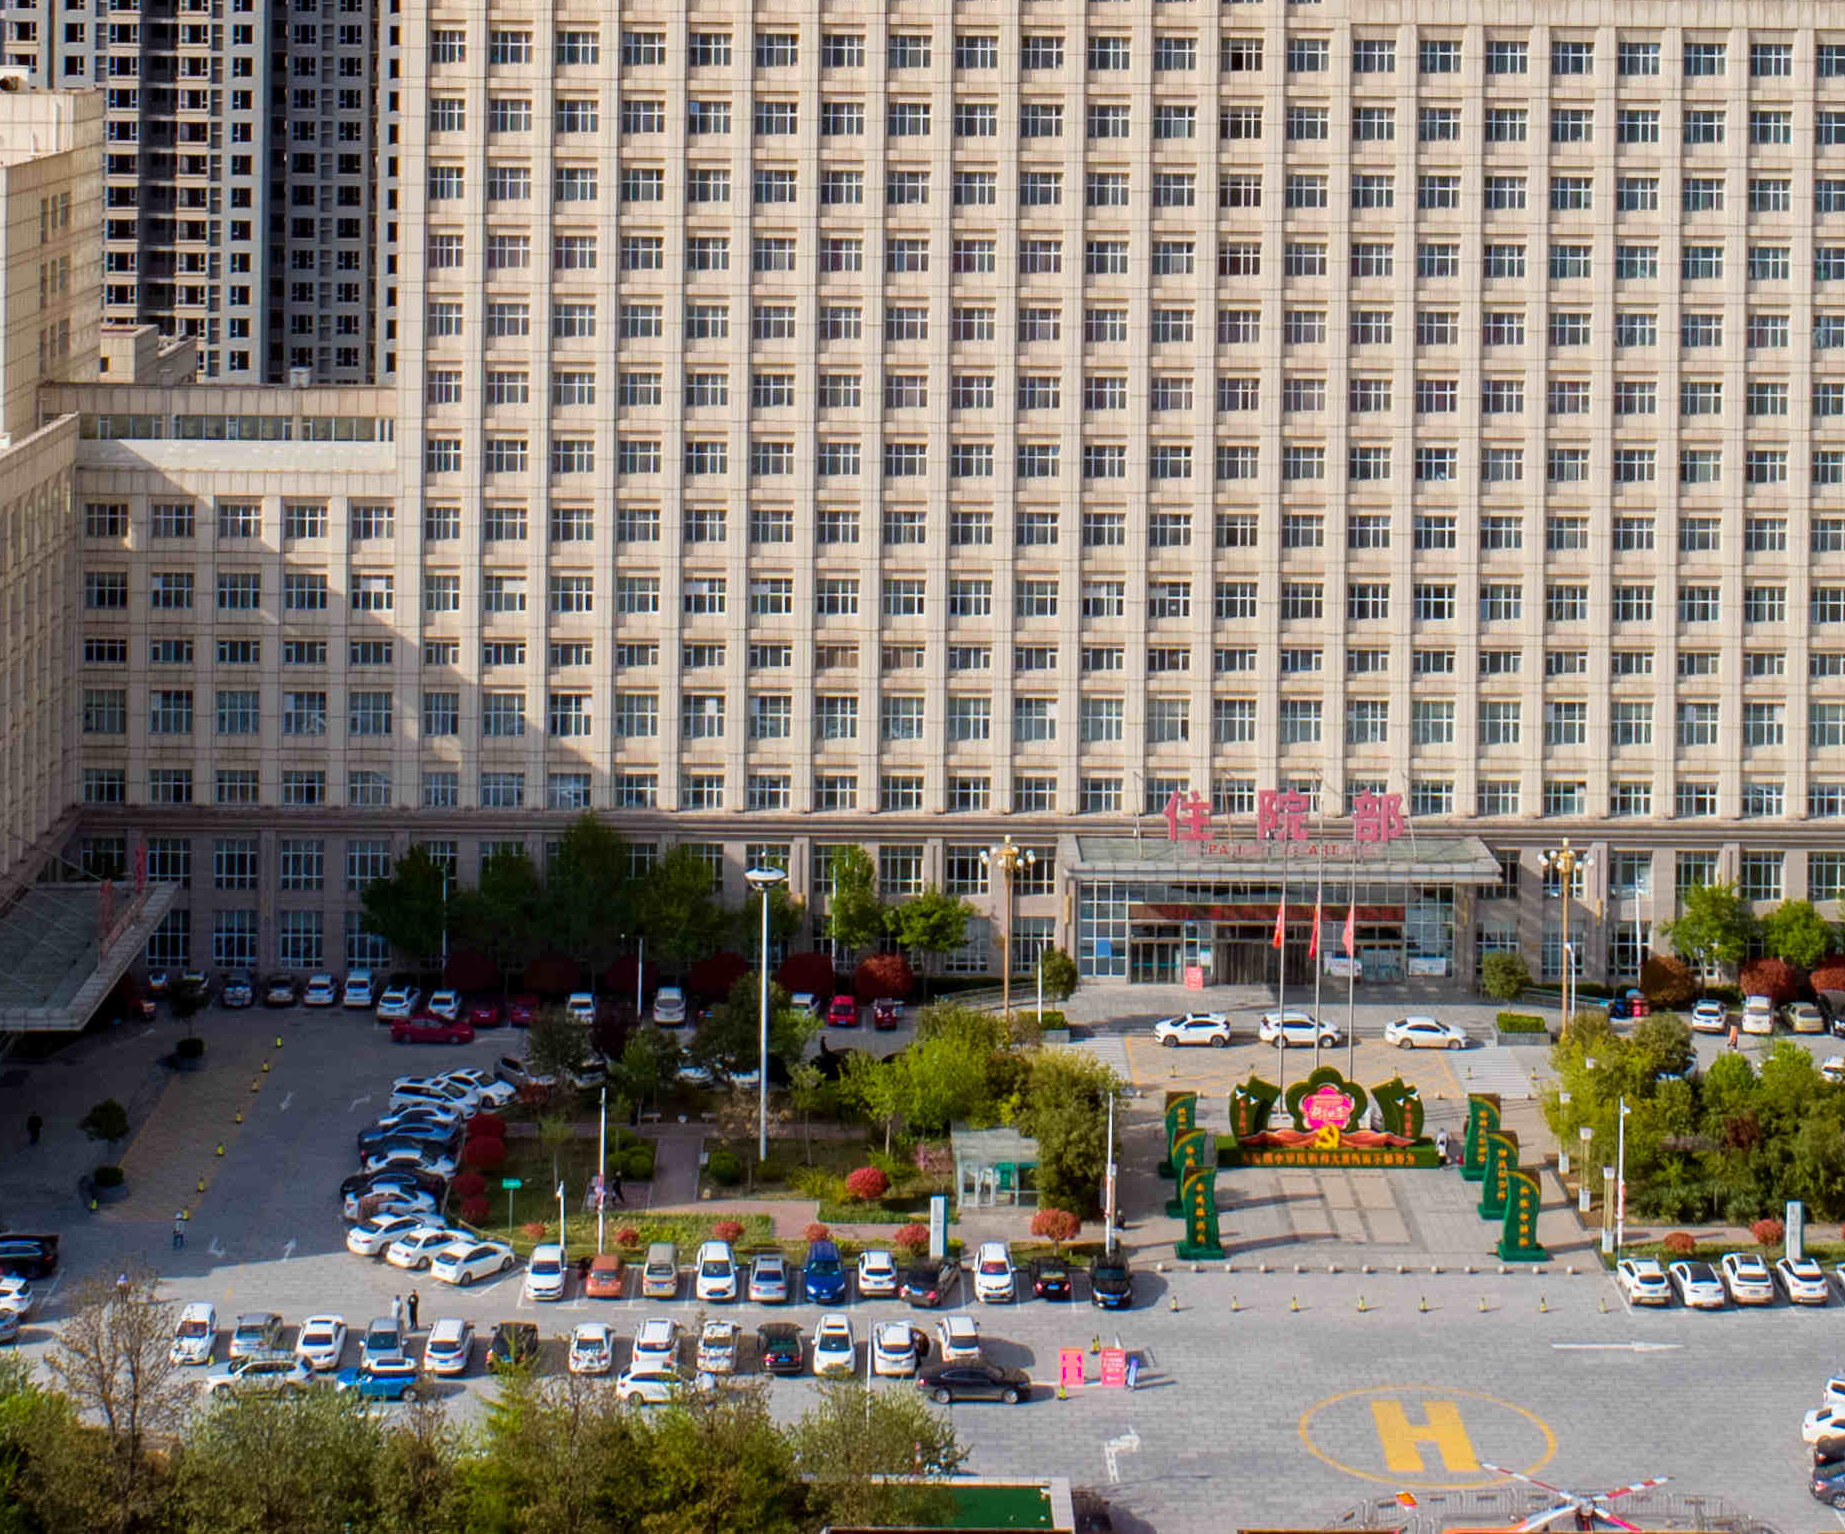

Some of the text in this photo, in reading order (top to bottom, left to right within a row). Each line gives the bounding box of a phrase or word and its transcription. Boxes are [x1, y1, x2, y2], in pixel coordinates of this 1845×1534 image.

[1163, 788, 1405, 842] 住院部
[1371, 1400, 1481, 1472] H
